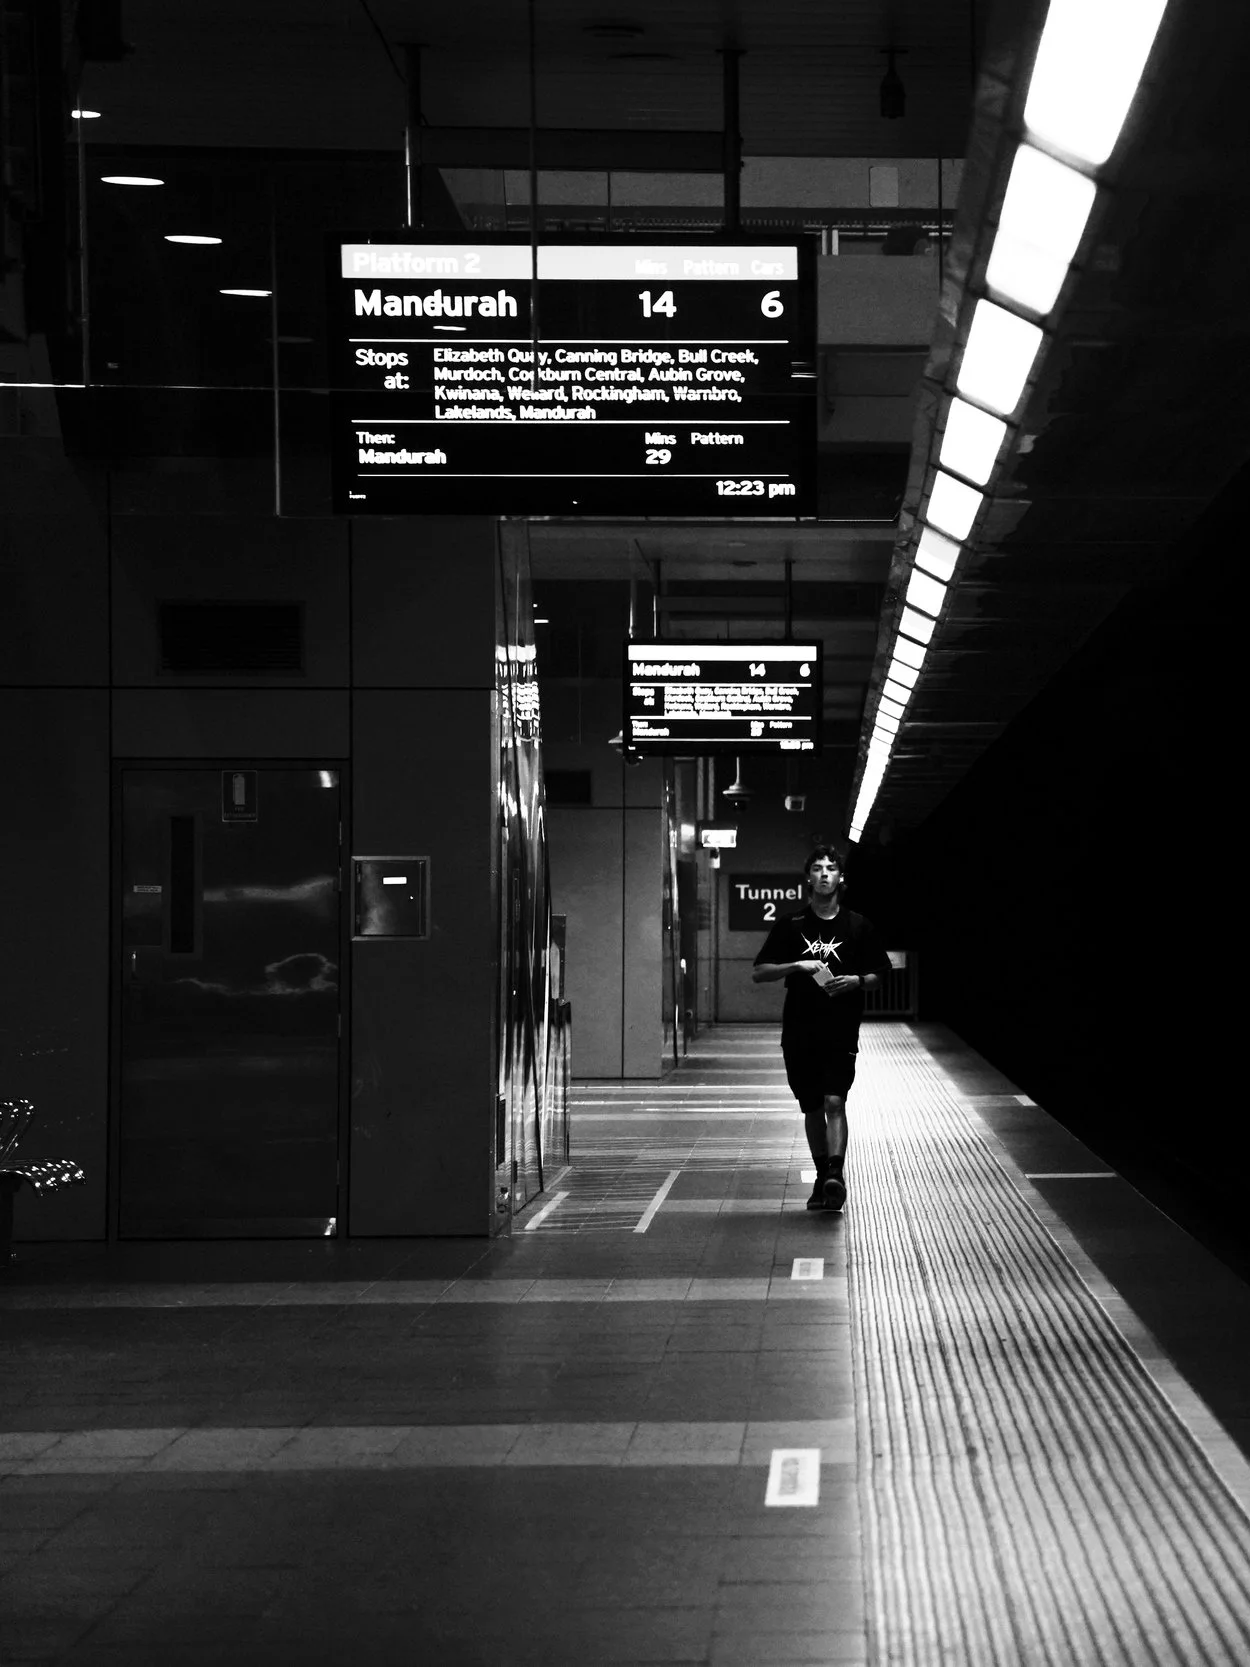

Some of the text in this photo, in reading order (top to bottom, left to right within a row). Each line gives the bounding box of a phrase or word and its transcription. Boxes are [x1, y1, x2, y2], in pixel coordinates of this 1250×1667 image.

[353, 252, 481, 274] Platform 2
[634, 258, 784, 275] Mins Pattern Cars
[354, 288, 784, 318] Mandurah 14 6
[355, 348, 409, 369] Stops
[433, 347, 505, 363] Elizabeth
[554, 348, 618, 366] Canning
[620, 348, 676, 366] Bridge,
[678, 348, 708, 364] Bull
[710, 348, 760, 365] Creek,
[383, 371, 410, 390] at:
[433, 366, 746, 384] Murdoch, Cockburn Central, Aubin Grove,
[434, 385, 504, 403] Kwinana,
[571, 385, 670, 404] Rockingham,
[672, 385, 743, 403] Warnbro,
[434, 404, 597, 421] Lakelands, Mandurah
[355, 431, 396, 444] Then:
[644, 431, 744, 445] Mins Pattern
[358, 448, 672, 465] Mandurah 29
[715, 480, 796, 499] 12:23 pm
[632, 662, 701, 677] Mandurah
[749, 663, 767, 677] 14
[735, 884, 802, 900] Tunnel
[763, 902, 777, 921] 2
